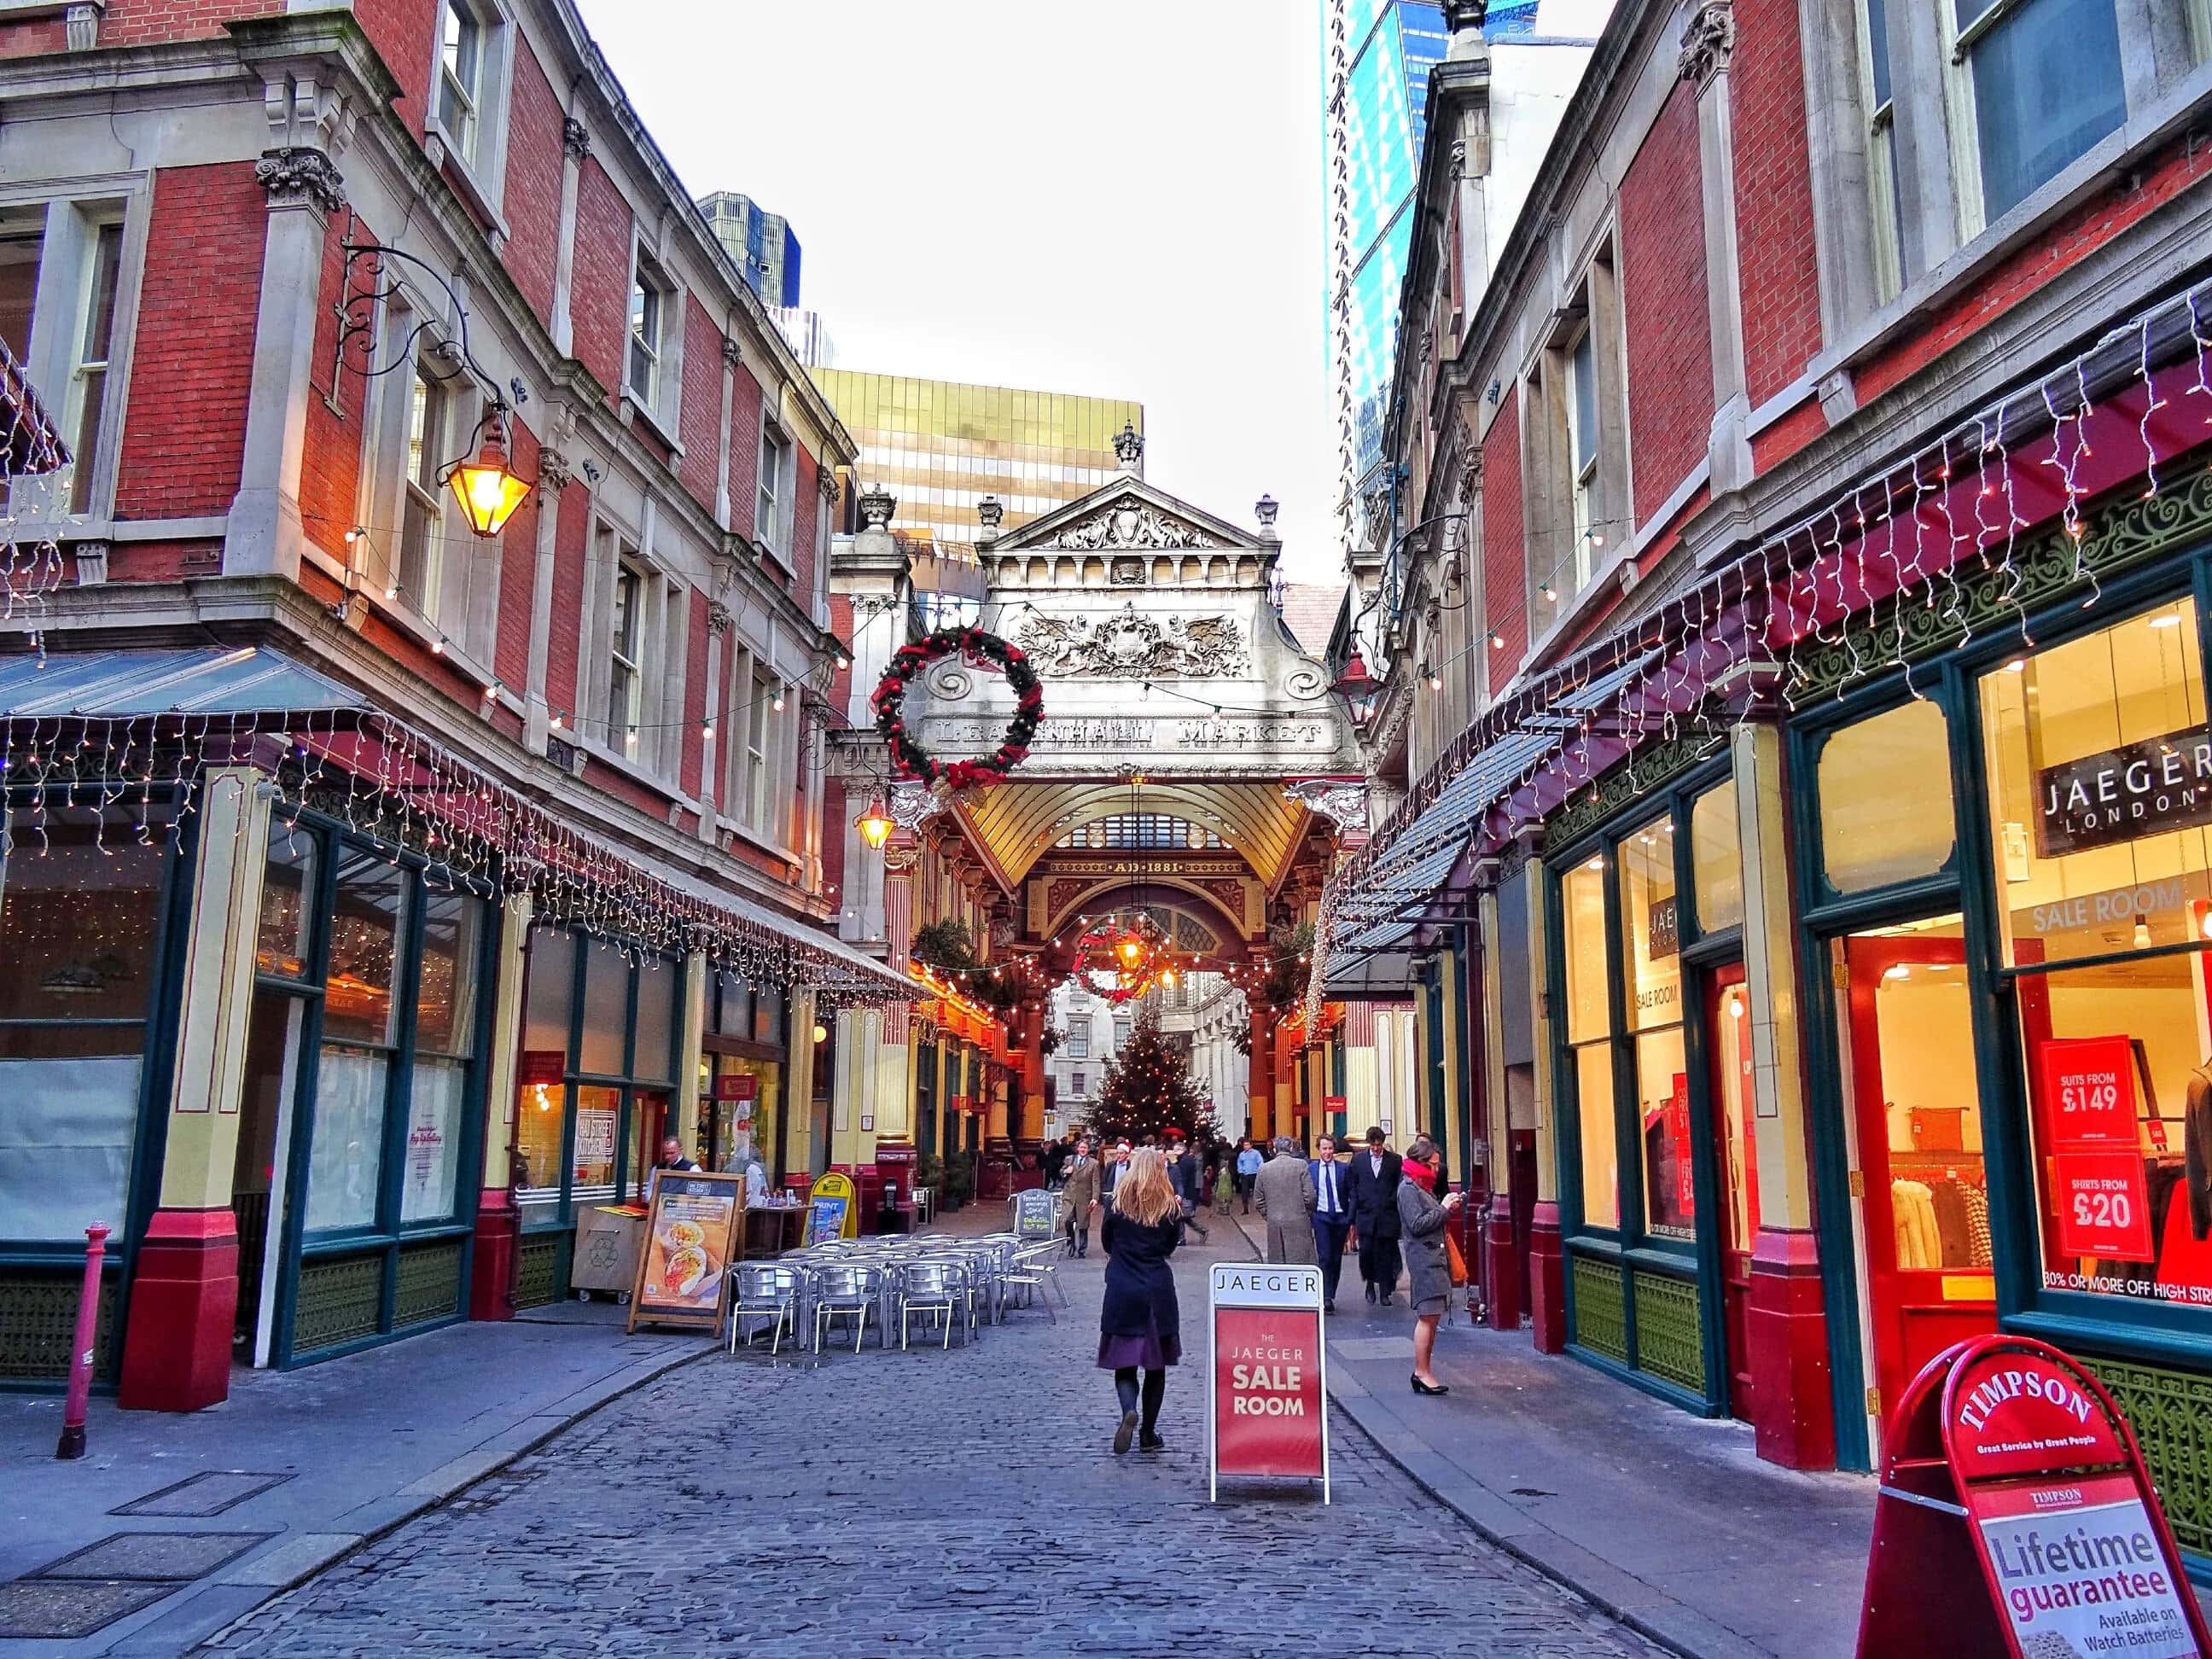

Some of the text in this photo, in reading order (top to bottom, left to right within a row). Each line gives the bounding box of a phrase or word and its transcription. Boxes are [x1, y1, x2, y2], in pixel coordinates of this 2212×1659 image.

[936, 720, 1322, 743] LEAENHALL MARKET
[2044, 743, 2212, 816] JAEGER
[2065, 788, 2196, 834] LONDON
[1147, 863, 1179, 872] 1881
[2033, 880, 2185, 932] SALE ROOM
[1651, 907, 1678, 934] JAE
[1637, 984, 1678, 1010] SALE ROOM
[2061, 1072, 2116, 1086] SUITS FROM
[2062, 1085, 2117, 1113] £149
[2071, 1179, 2128, 1191] SHIRTS FROM
[814, 1201, 840, 1209] PRINT
[2073, 1192, 2131, 1228] £20
[1217, 1275, 1317, 1292] JAEGER
[2069, 1273, 2086, 1289] OR
[2088, 1276, 2124, 1294] MORE
[2127, 1279, 2151, 1296] OFF
[2153, 1283, 2187, 1300] HIGH
[2190, 1285, 2212, 1303] STR
[1261, 1334, 1275, 1342] THE
[1232, 1347, 1303, 1360] JAEGER
[1232, 1364, 1301, 1391] SALE
[1234, 1396, 1305, 1417] ROOM
[1959, 1371, 2093, 1433] TIMPSON
[1976, 1435, 2097, 1454] Great Service by Great People
[2030, 1487, 2082, 1503] TIMPSON
[1990, 1527, 2156, 1579] Lifetime
[2010, 1569, 2168, 1622] guarantee
[2098, 1608, 2177, 1629] Available on
[2084, 1626, 2186, 1651] Watch Batteries
